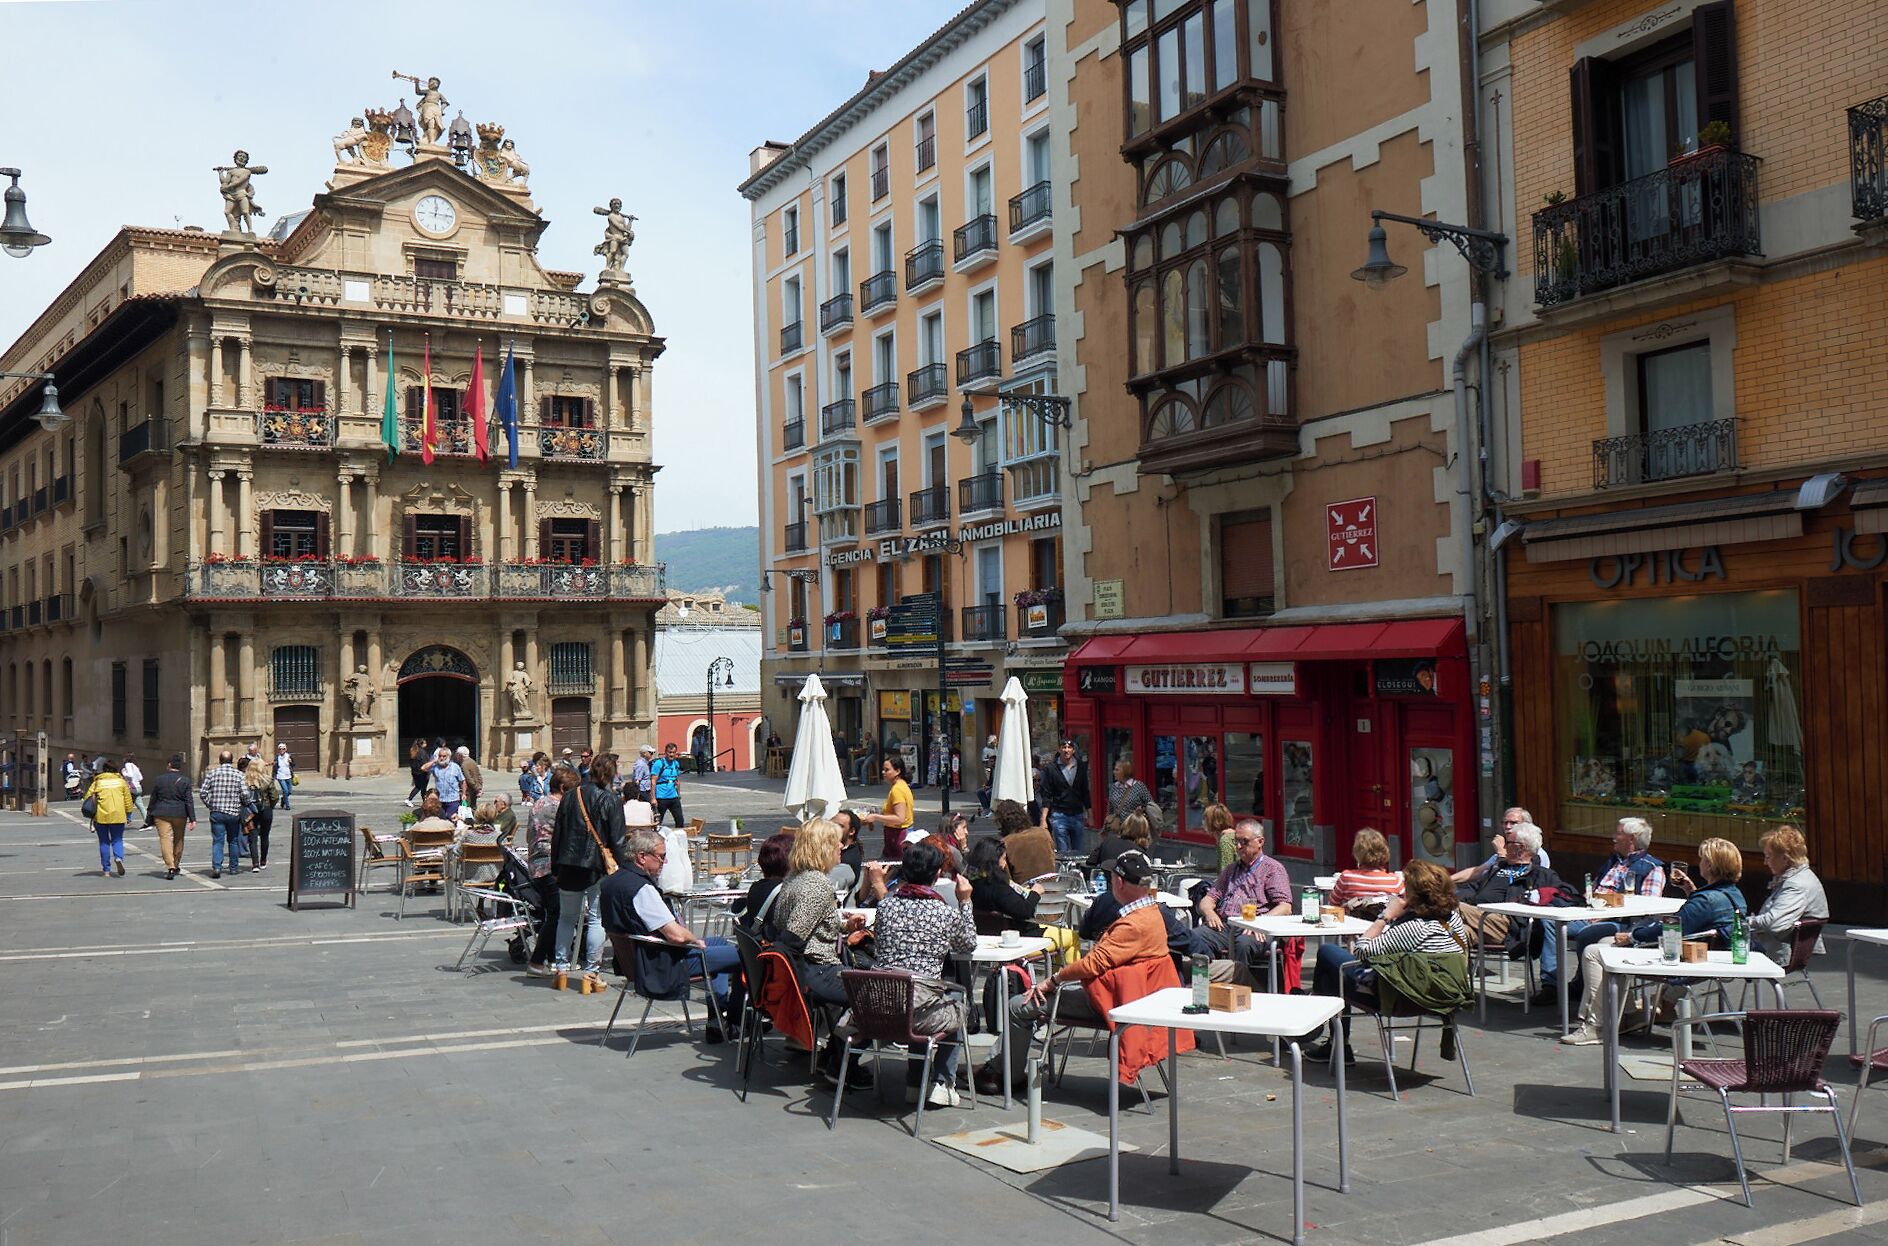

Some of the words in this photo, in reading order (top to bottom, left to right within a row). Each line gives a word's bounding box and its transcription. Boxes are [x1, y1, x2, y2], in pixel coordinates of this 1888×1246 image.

[824, 548, 872, 567] AGENCIA
[959, 512, 1061, 543] INMOBILIARIA
[1331, 528, 1374, 541] GUTIERREZ
[1575, 637, 1672, 663] JOAQUIN
[1093, 675, 1116, 684] KANGOL
[1141, 668, 1228, 688] GUTIERREZ
